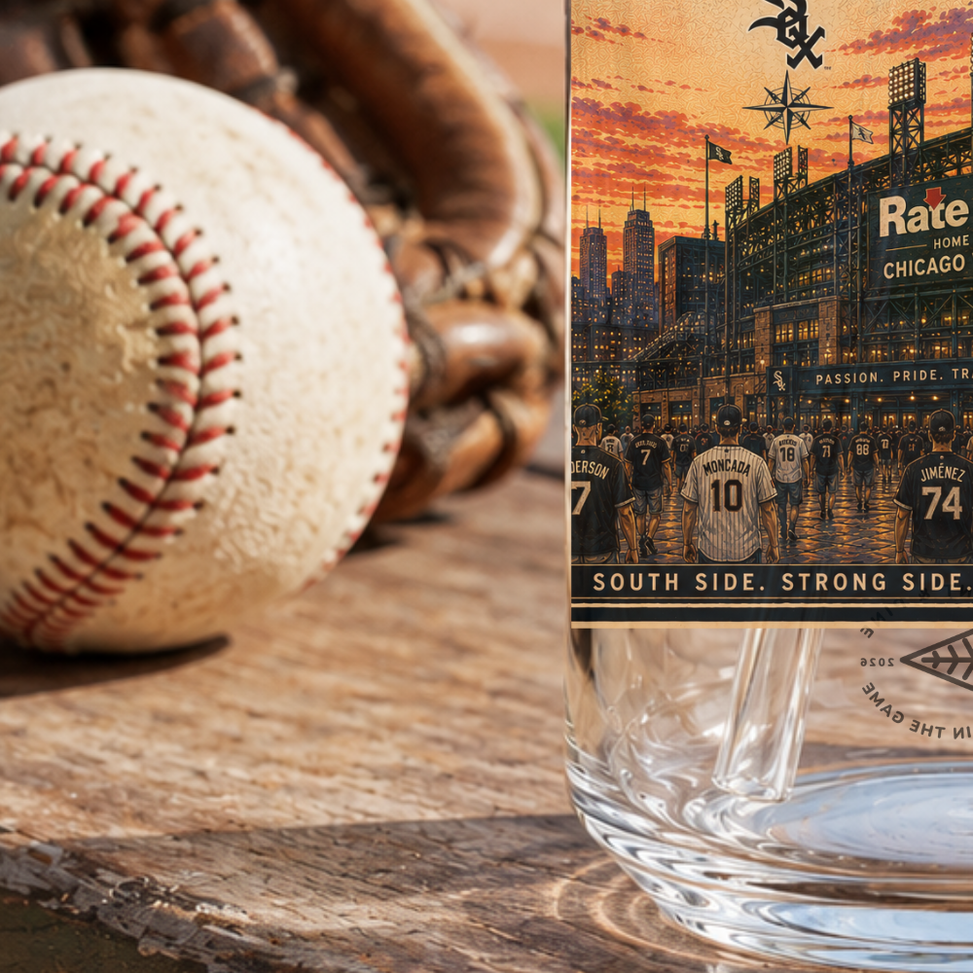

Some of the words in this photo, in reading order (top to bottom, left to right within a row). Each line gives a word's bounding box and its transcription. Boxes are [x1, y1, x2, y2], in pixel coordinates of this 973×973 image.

[879, 196, 970, 238] Rate
[932, 235, 970, 250] HOME
[883, 255, 966, 281] CHICAGO
[815, 371, 884, 386] PASSION.
[893, 368, 944, 382] PRIDE.
[640, 448, 652, 466] 7
[702, 458, 751, 477] MONCADA
[920, 462, 966, 484] JIMÉNEZ
[711, 478, 743, 513] 10
[921, 485, 963, 521] 74
[592, 572, 679, 592] SOUTH
[694, 572, 766, 592] SIDE.
[781, 572, 887, 592] STRONG
[901, 572, 973, 592] SIDE.
